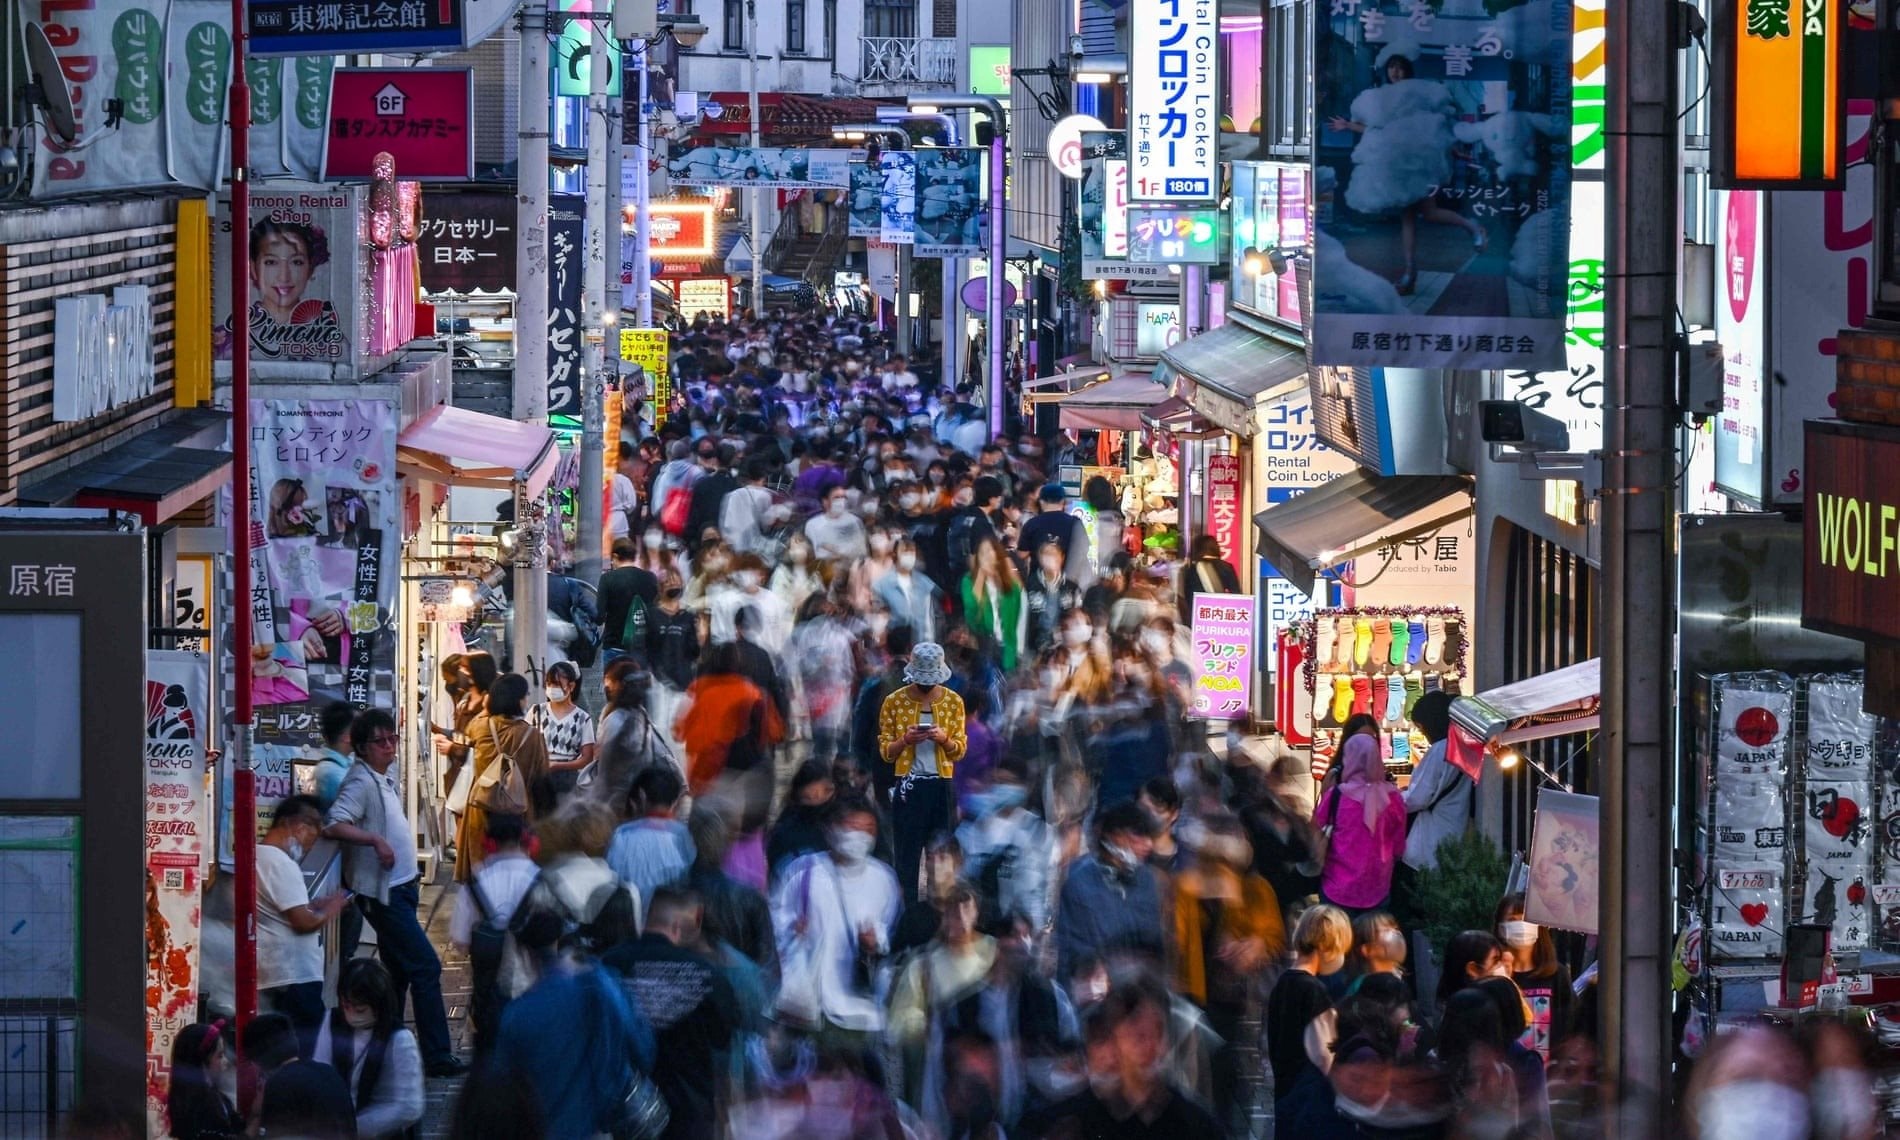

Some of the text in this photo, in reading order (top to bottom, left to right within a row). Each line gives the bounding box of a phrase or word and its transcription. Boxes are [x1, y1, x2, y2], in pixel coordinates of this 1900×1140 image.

[257, 1, 426, 32] 原宿 東郷記念館
[1195, 36, 1211, 84] Coin
[380, 96, 401, 111] 6F
[330, 118, 460, 139] 宿ダンスアカデミー
[1195, 94, 1210, 168] Locker
[1139, 113, 1151, 168] 竹下通り
[1138, 177, 1161, 196] 1F
[1427, 184, 1511, 201] ファッション
[247, 193, 349, 208] imono Rental
[271, 209, 312, 226] Shop
[417, 218, 510, 240] アクセサリー
[434, 247, 498, 265] 日本一
[553, 230, 575, 302] ギャラリー
[279, 343, 342, 356] TOKYO
[1351, 331, 1536, 354] 原宿竹下通り商店会
[547, 307, 579, 412] ハセガワ
[1267, 404, 1315, 425] コイ
[251, 425, 372, 443] ロマンティック
[276, 447, 348, 464] ヒロイン
[1267, 456, 1311, 468] Rental
[1267, 470, 1298, 482] Coin
[1817, 492, 1900, 578] WOLF
[1421, 564, 1431, 575] by
[1434, 564, 1458, 573] Tabio
[9, 563, 77, 597] 原宿
[1272, 592, 1310, 605] コイン
[1199, 607, 1250, 622] 都内最大
[1195, 625, 1250, 637] PURIKURA
[1197, 640, 1247, 657] プリクラ
[1205, 660, 1237, 673] ランド
[1198, 676, 1243, 691] NOA
[1220, 700, 1242, 711] ノア
[149, 758, 193, 769] OKYO
[1734, 749, 1777, 763] JAPAN
[1718, 931, 1762, 942] JAPAN
